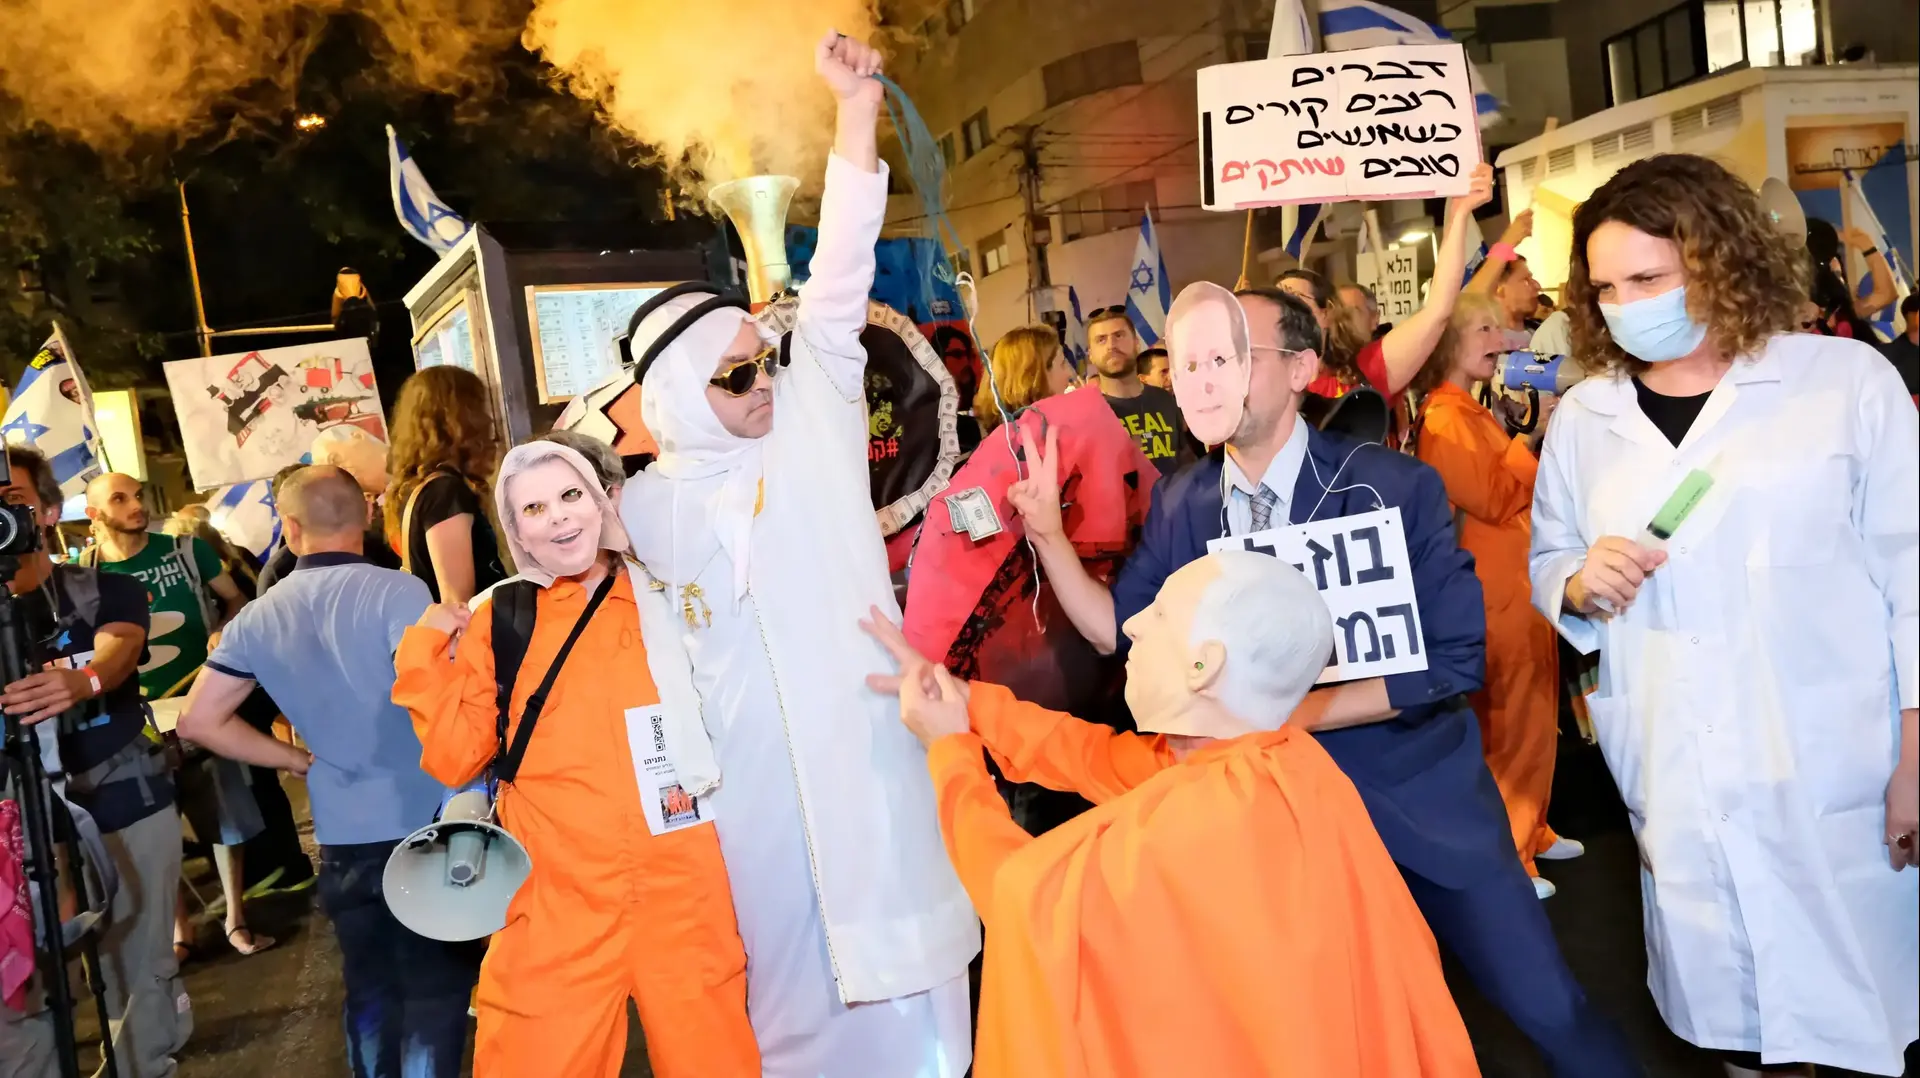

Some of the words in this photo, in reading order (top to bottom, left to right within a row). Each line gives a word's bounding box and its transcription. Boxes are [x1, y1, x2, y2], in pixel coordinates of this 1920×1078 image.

[1291, 61, 1448, 88] דברים
[1225, 97, 1329, 128] קורים
[1345, 89, 1456, 116] רעים
[1297, 122, 1462, 149] כשאנשים
[1220, 155, 1345, 190] שותקים
[1360, 153, 1460, 179] טובים
[1387, 254, 1412, 274] הלא
[1140, 434, 1176, 459] EAL
[1327, 603, 1419, 666] המ
[643, 755, 667, 766] נתניהו
